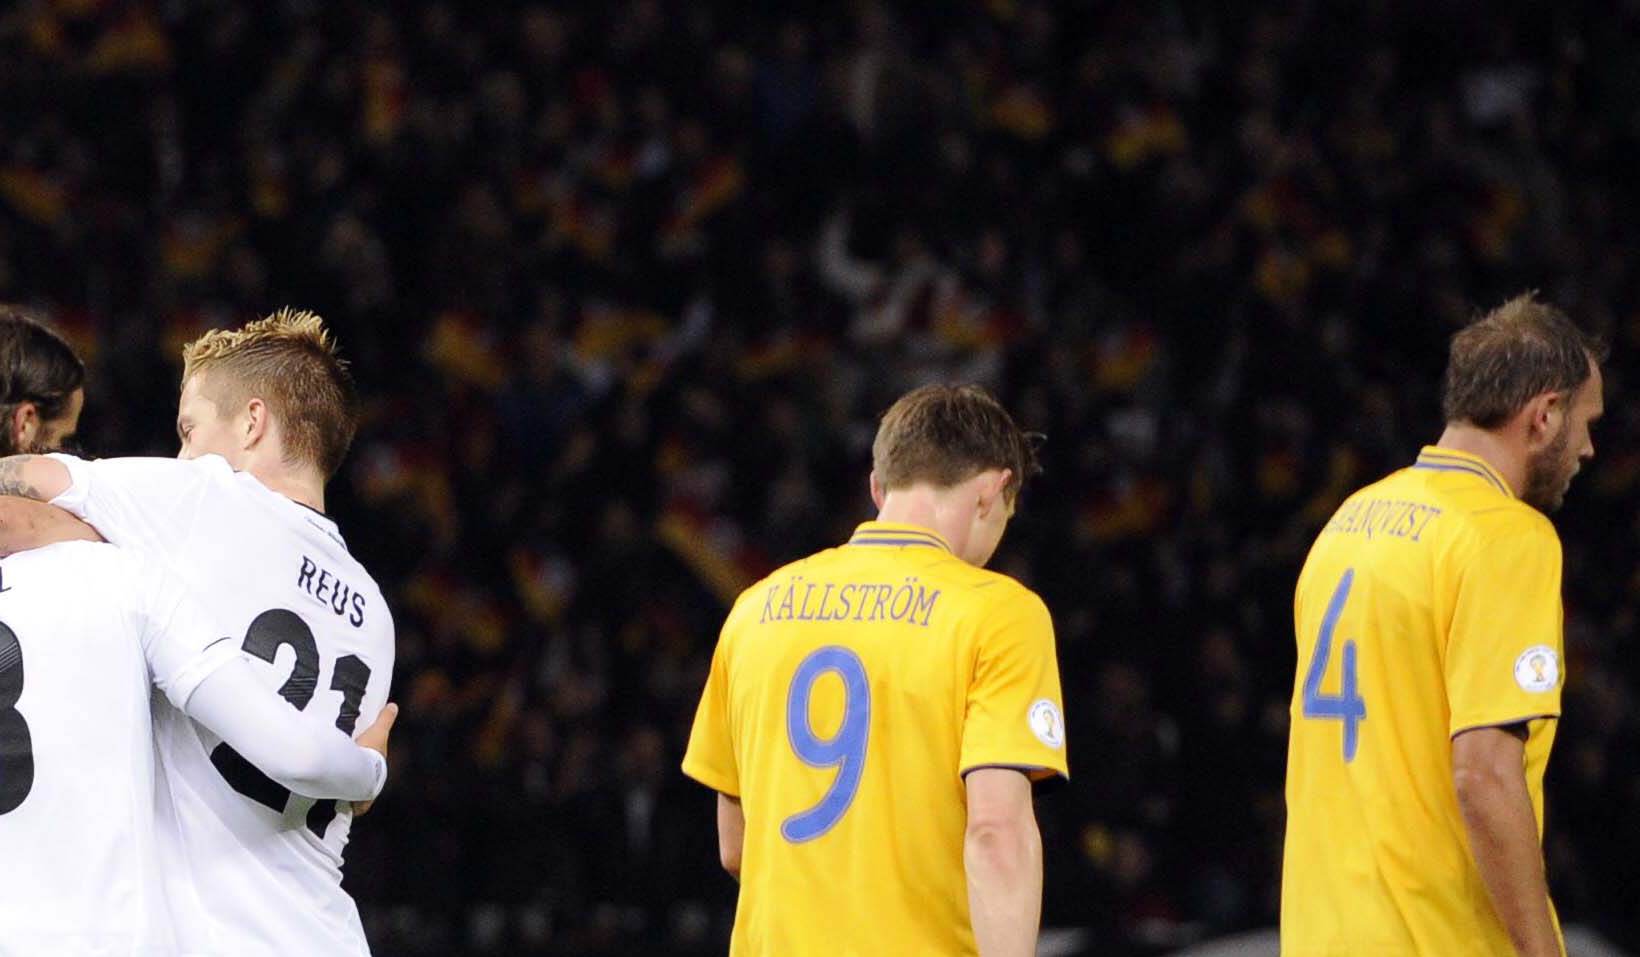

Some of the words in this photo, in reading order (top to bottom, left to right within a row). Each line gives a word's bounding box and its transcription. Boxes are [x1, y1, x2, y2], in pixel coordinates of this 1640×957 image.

[297, 554, 366, 628] REUS
[760, 575, 942, 627] KÄLLSTRÖM
[1302, 565, 1366, 765] 4
[781, 645, 872, 845] 9
